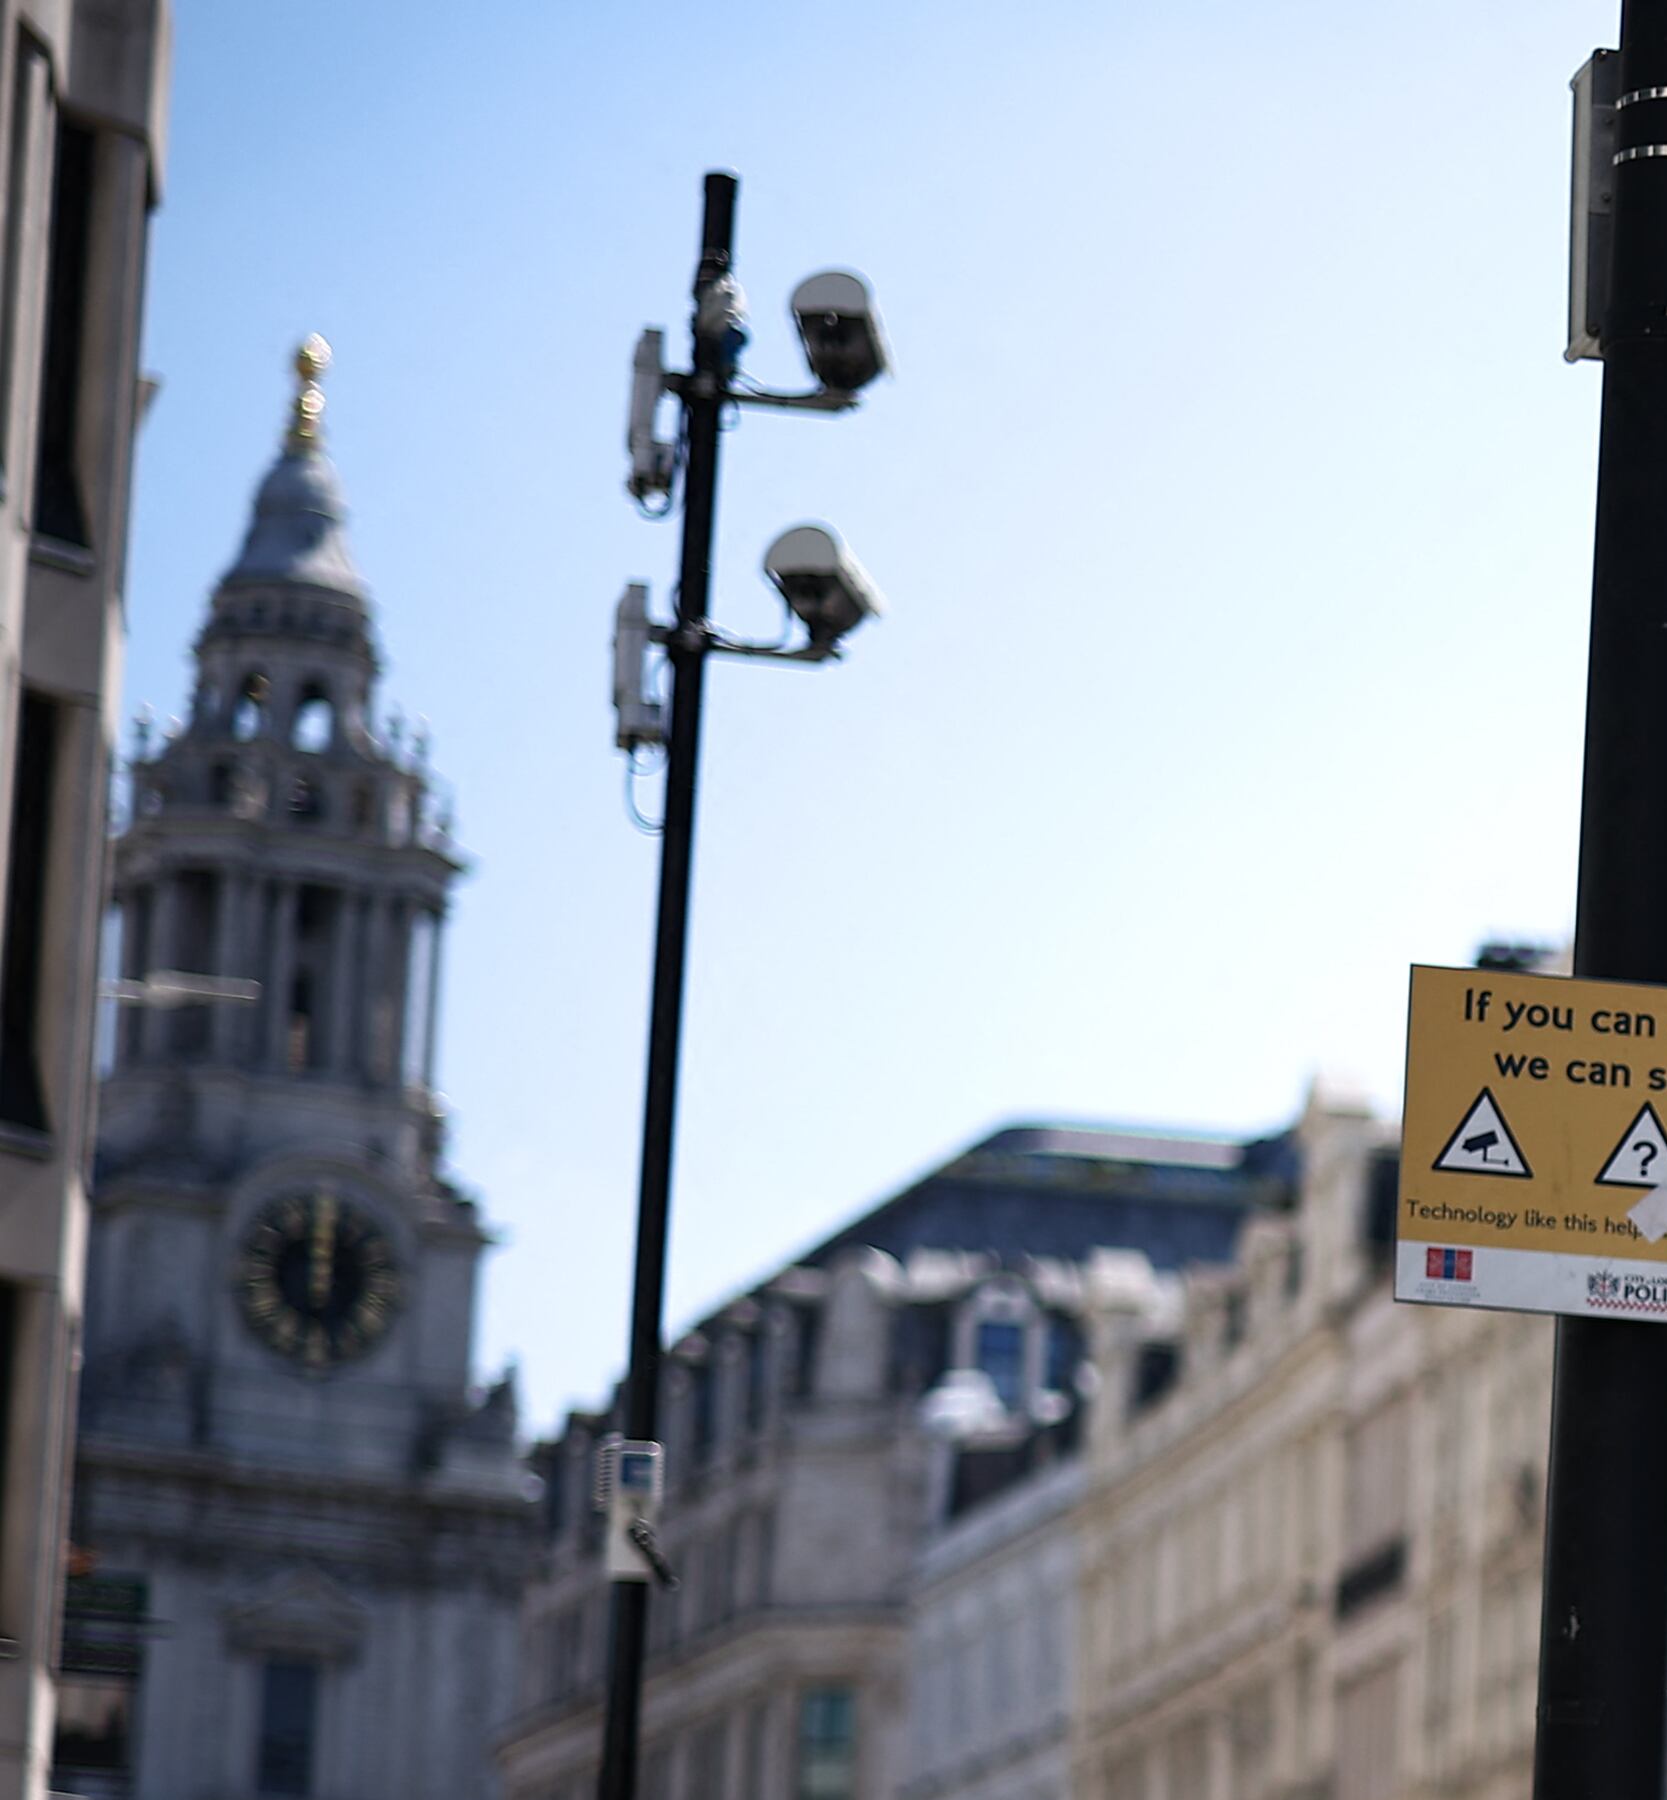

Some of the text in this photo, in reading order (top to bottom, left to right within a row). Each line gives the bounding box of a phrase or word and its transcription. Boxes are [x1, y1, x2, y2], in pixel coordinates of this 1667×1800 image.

[1464, 988, 1491, 1021] If
[1502, 1000, 1573, 1031] you
[1591, 1009, 1655, 1037] can
[1495, 1052, 1549, 1080] we
[1566, 1059, 1630, 1087] can
[1407, 1199, 1518, 1230] Technology
[1525, 1209, 1557, 1230] like
[1564, 1213, 1597, 1233] this
